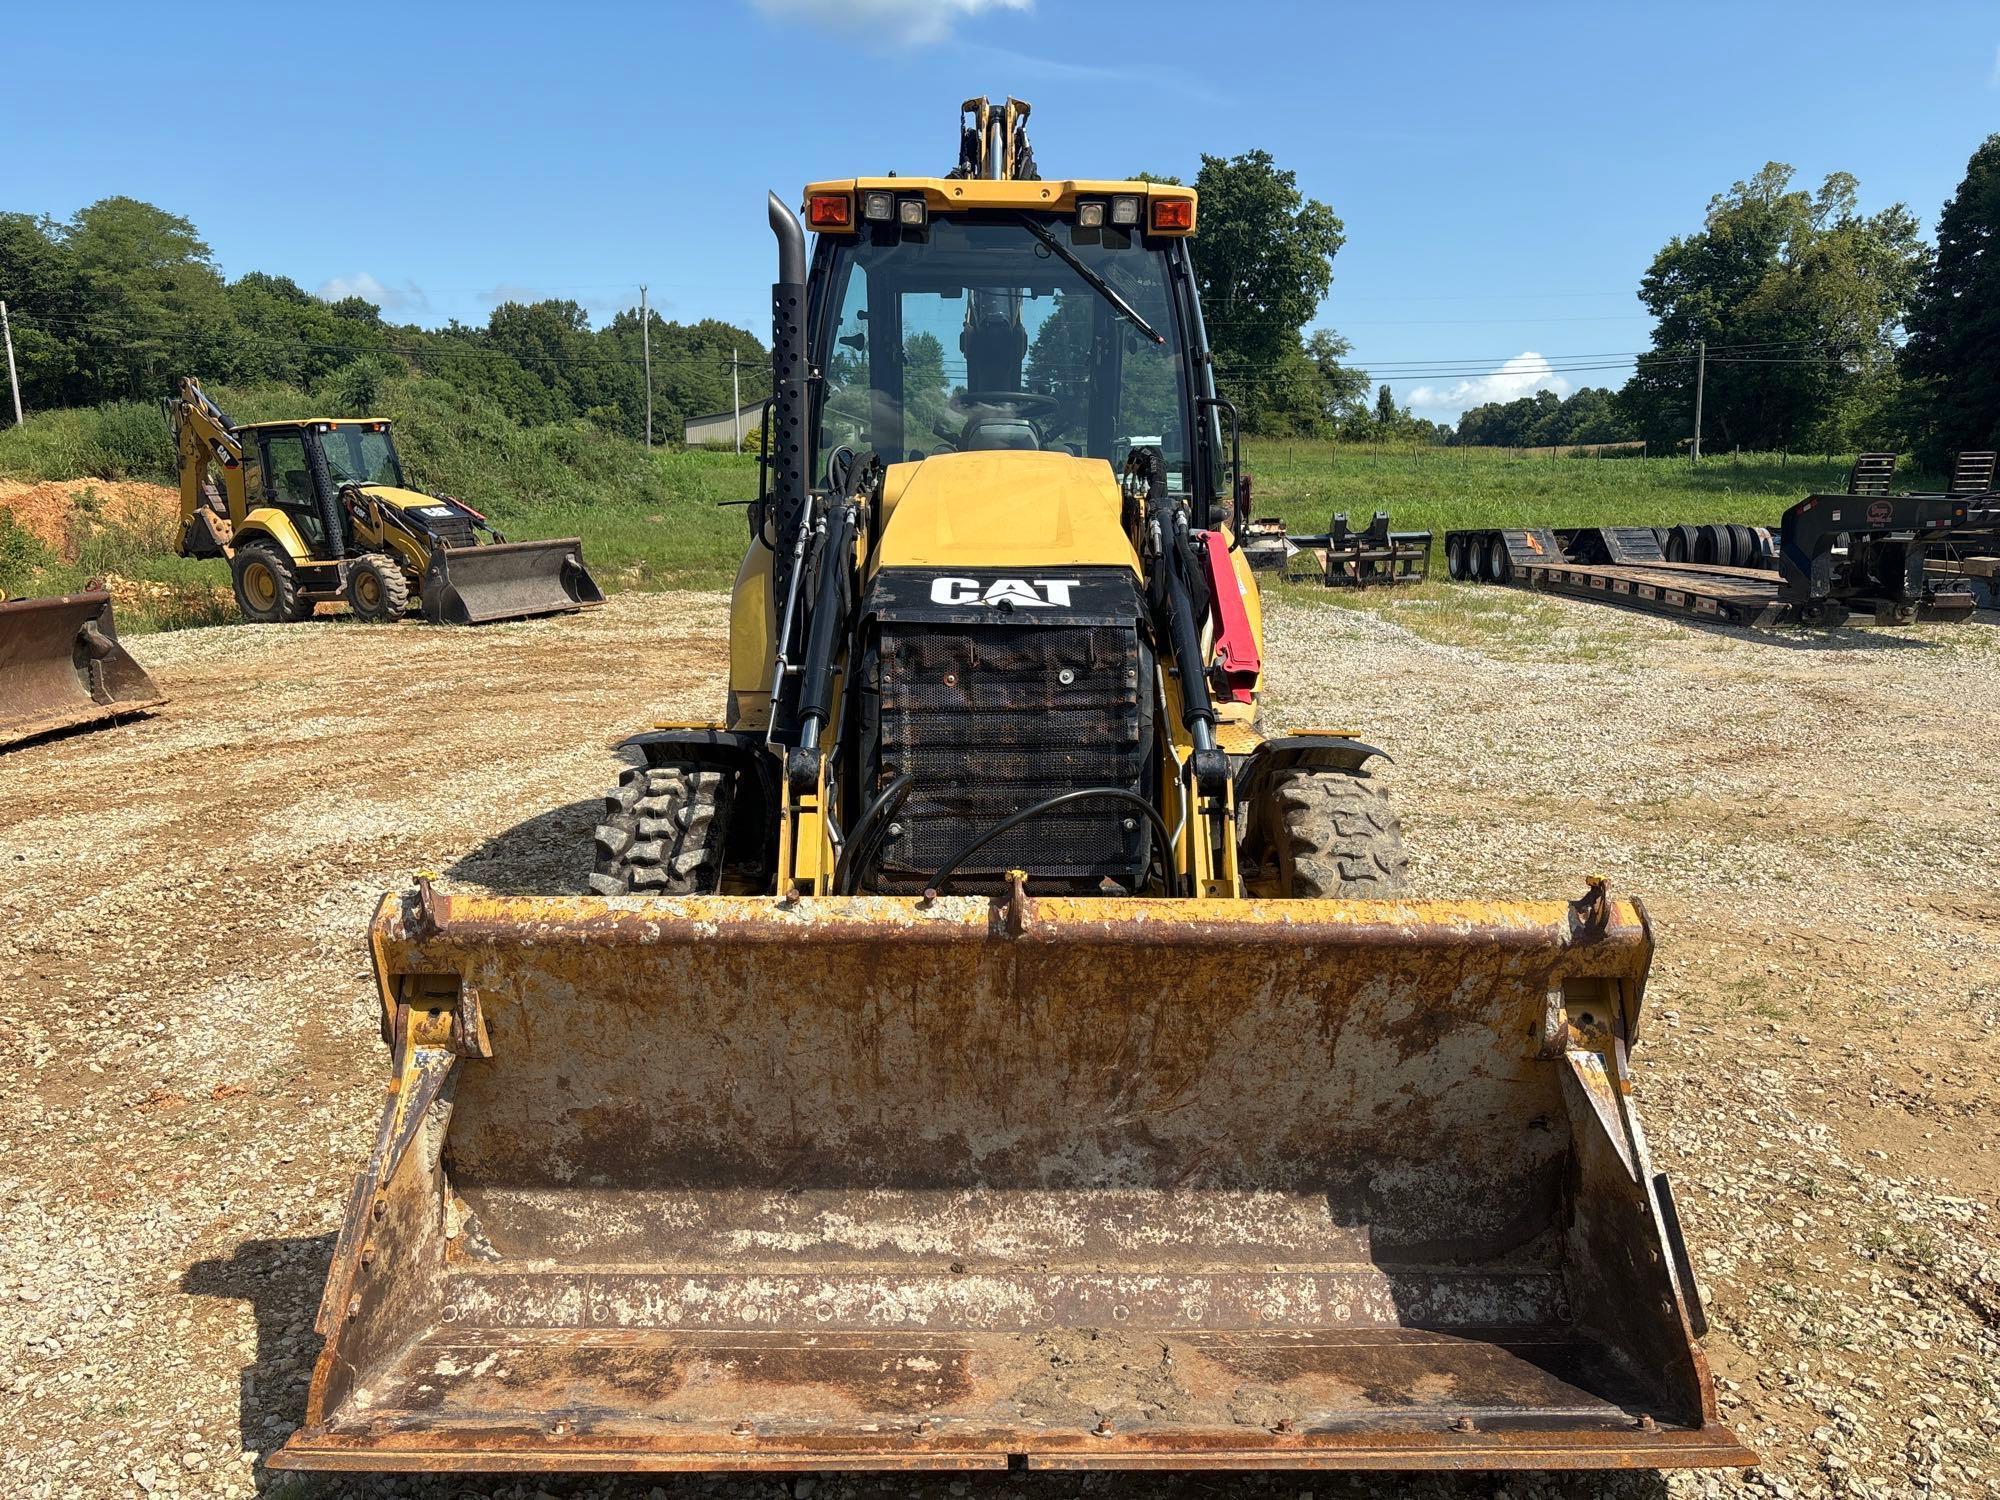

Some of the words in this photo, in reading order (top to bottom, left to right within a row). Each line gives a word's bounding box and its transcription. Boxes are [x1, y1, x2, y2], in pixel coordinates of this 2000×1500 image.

[217, 445, 231, 464] CAT
[421, 506, 455, 518] CAT
[930, 577, 1080, 607] CAT
